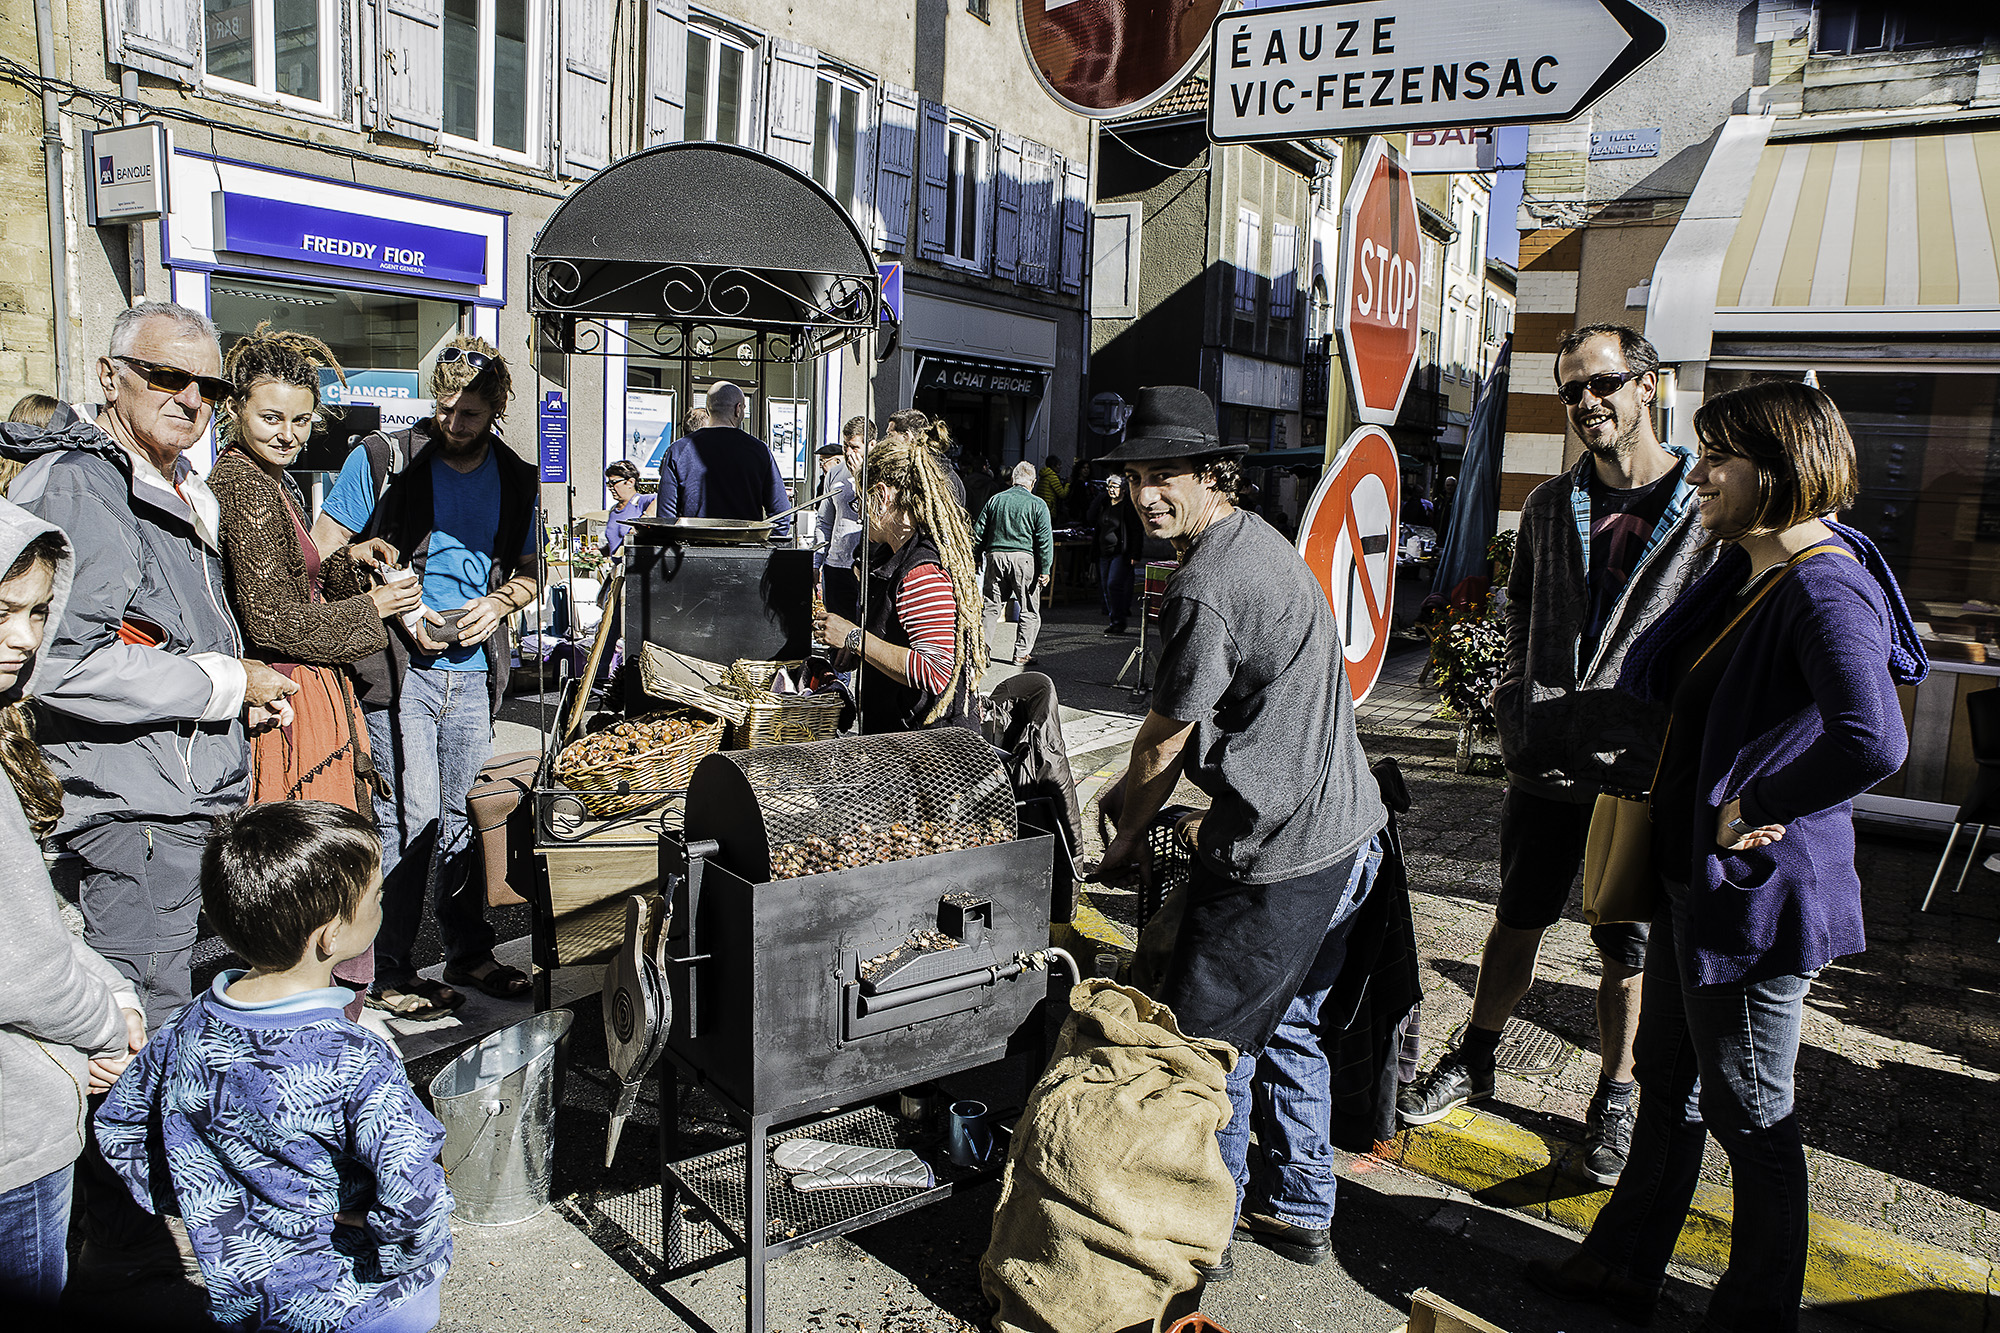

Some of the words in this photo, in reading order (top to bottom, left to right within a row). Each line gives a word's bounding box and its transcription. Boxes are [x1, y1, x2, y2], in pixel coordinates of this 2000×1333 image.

[1231, 16, 1397, 69] ÉAUZE
[1231, 55, 1559, 118] VIC-FEZENSAC
[1413, 127, 1493, 146] BAR
[1609, 132, 1638, 142] PLACE
[1591, 144, 1626, 155] JEANNE
[1628, 142, 1658, 153] D'ARC
[116, 165, 151, 180] BANQUE
[302, 234, 377, 259] FREDDY
[383, 246, 425, 268] FIOR
[380, 262, 399, 271] AGENT
[399, 265, 425, 275] GENERAL
[1357, 238, 1416, 329] STOP
[936, 369, 947, 384] A
[953, 371, 986, 388] CHAT
[990, 376, 1032, 392] PERCHE
[380, 414, 420, 425] BANQ
